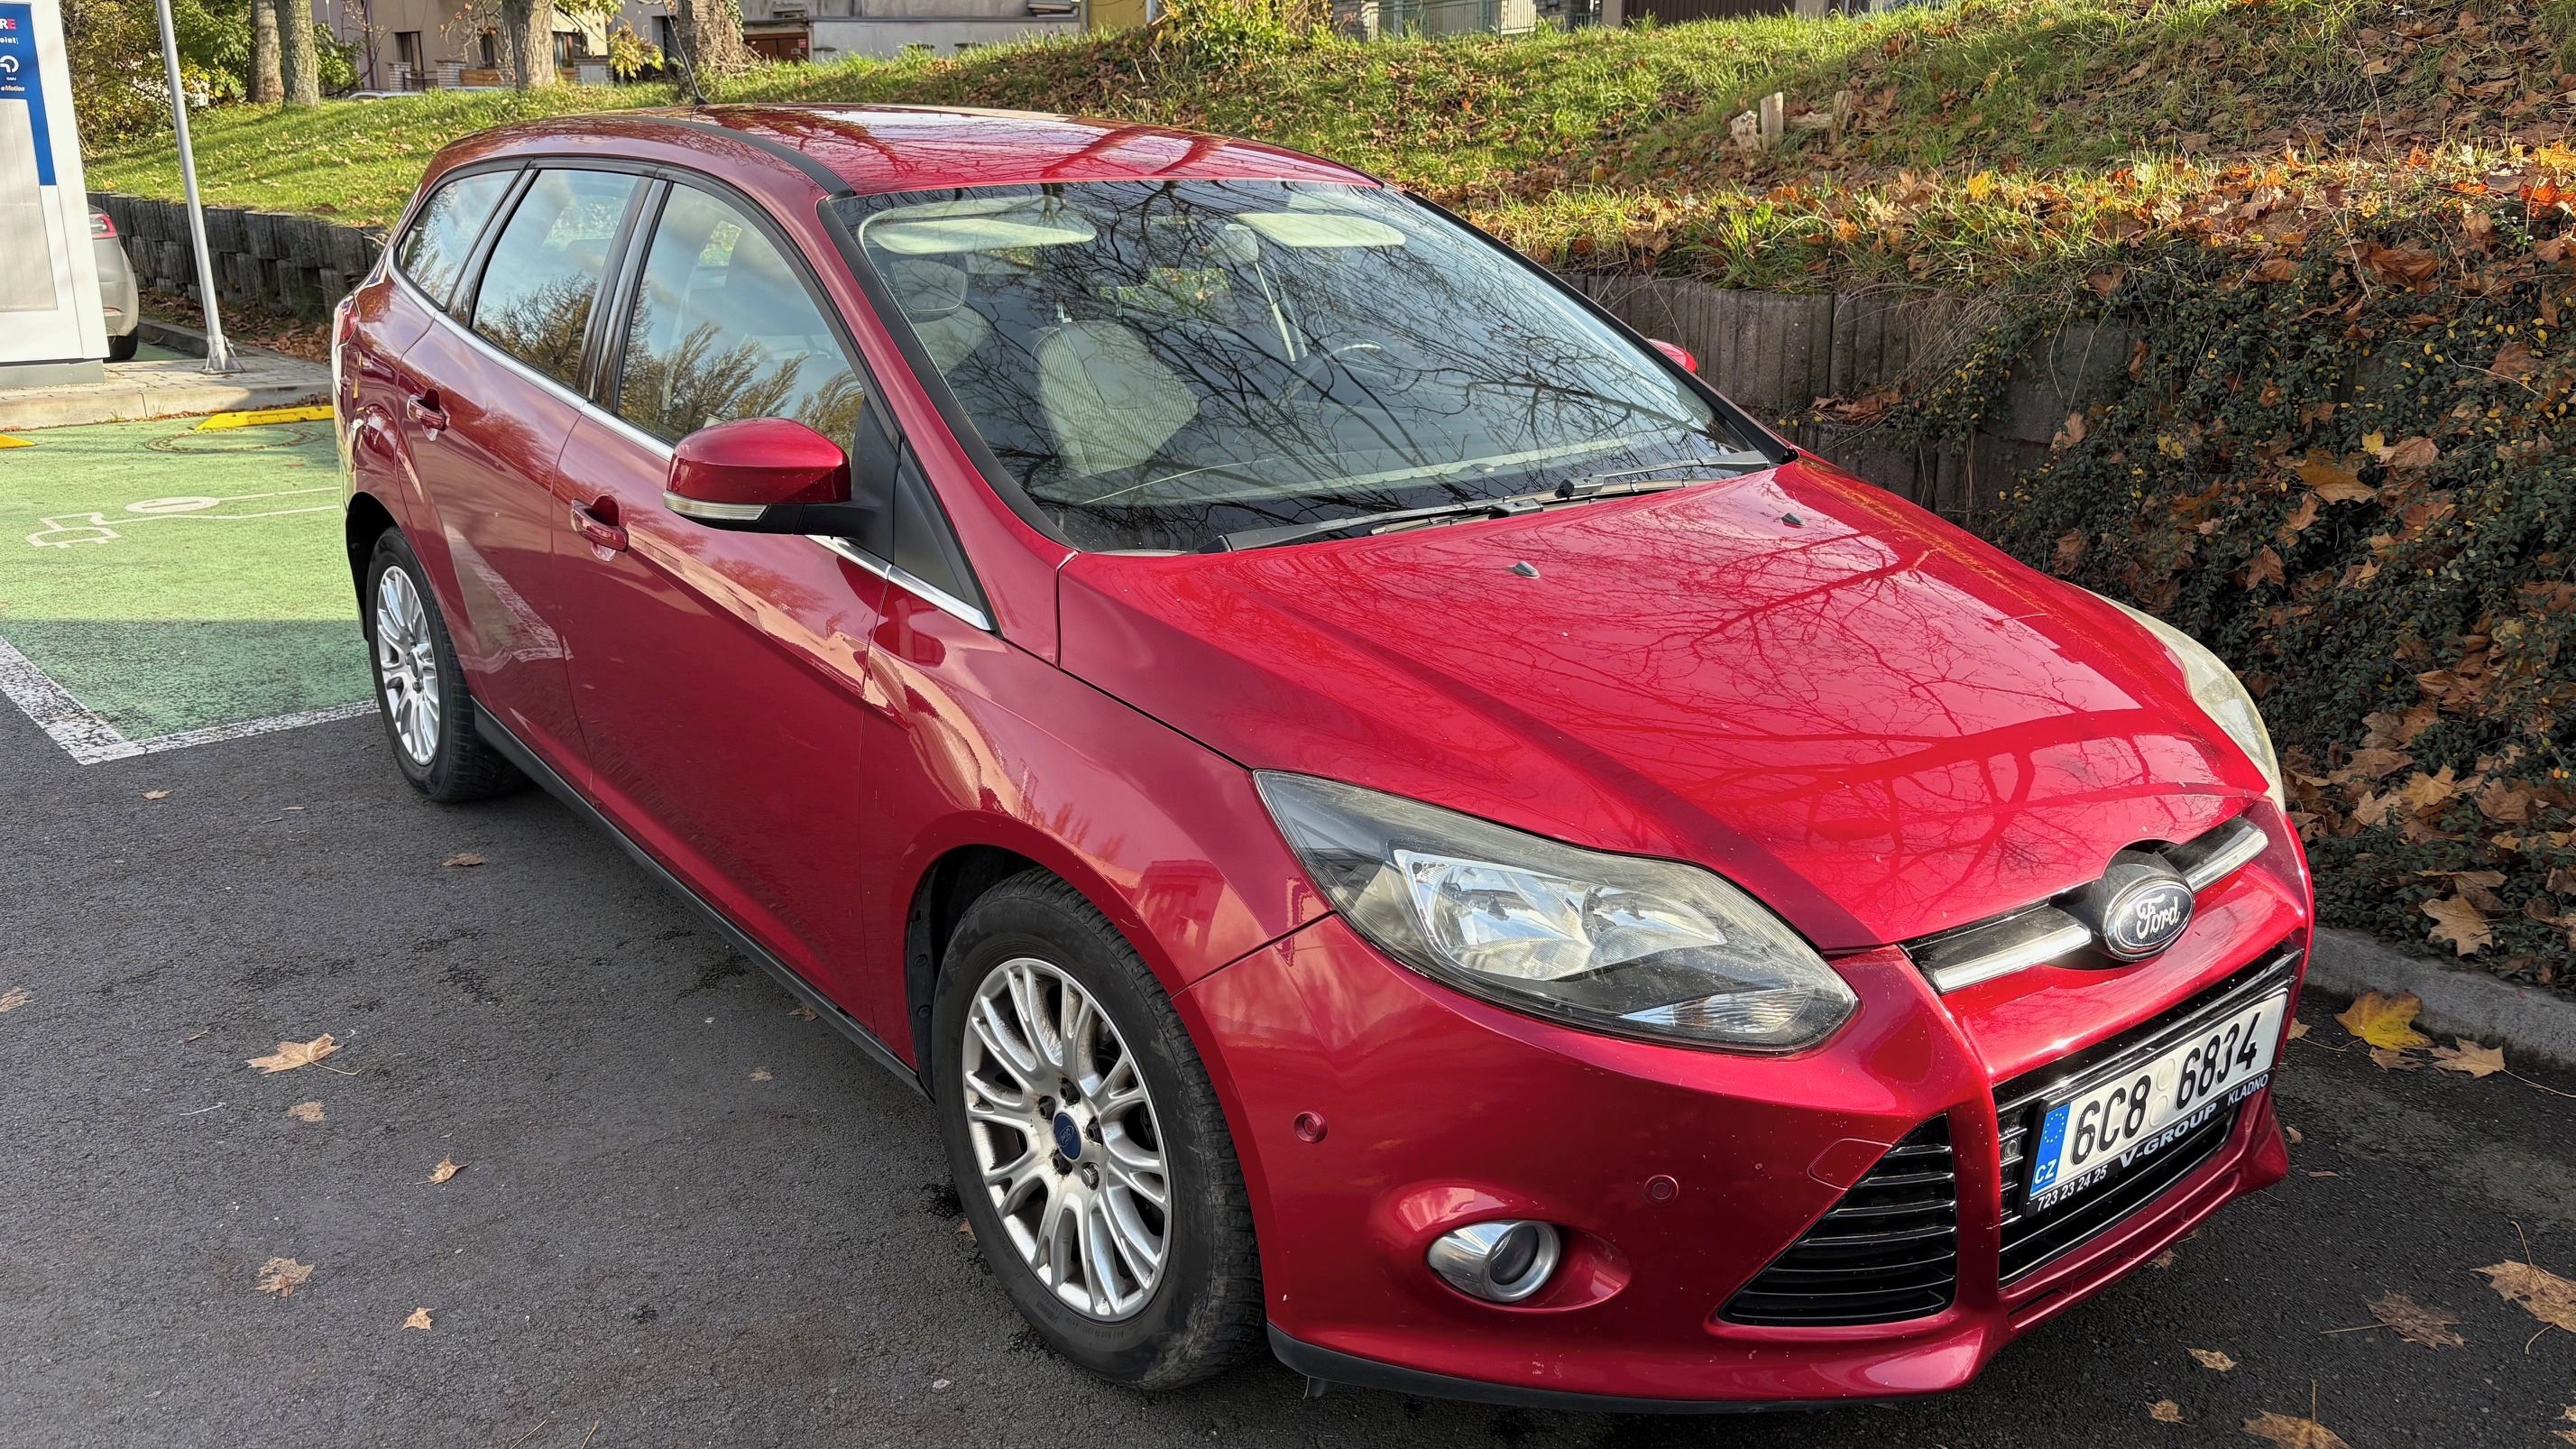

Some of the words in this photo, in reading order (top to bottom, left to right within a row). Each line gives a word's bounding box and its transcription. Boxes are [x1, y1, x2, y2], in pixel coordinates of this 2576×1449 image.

[2136, 893, 2180, 939] Ford
[2070, 1075, 2151, 1165] 6C8
[2176, 1011, 2261, 1110] 6834
[2227, 1073, 2268, 1106] KLADNO
[2119, 1103, 2217, 1168] V-GROUP
[2034, 1158, 2057, 1185] CZ
[2038, 1190, 2058, 1212] 723
[2060, 1181, 2075, 1201] 23
[2076, 1172, 2092, 1193] 24
[2093, 1164, 2108, 1184] 25
